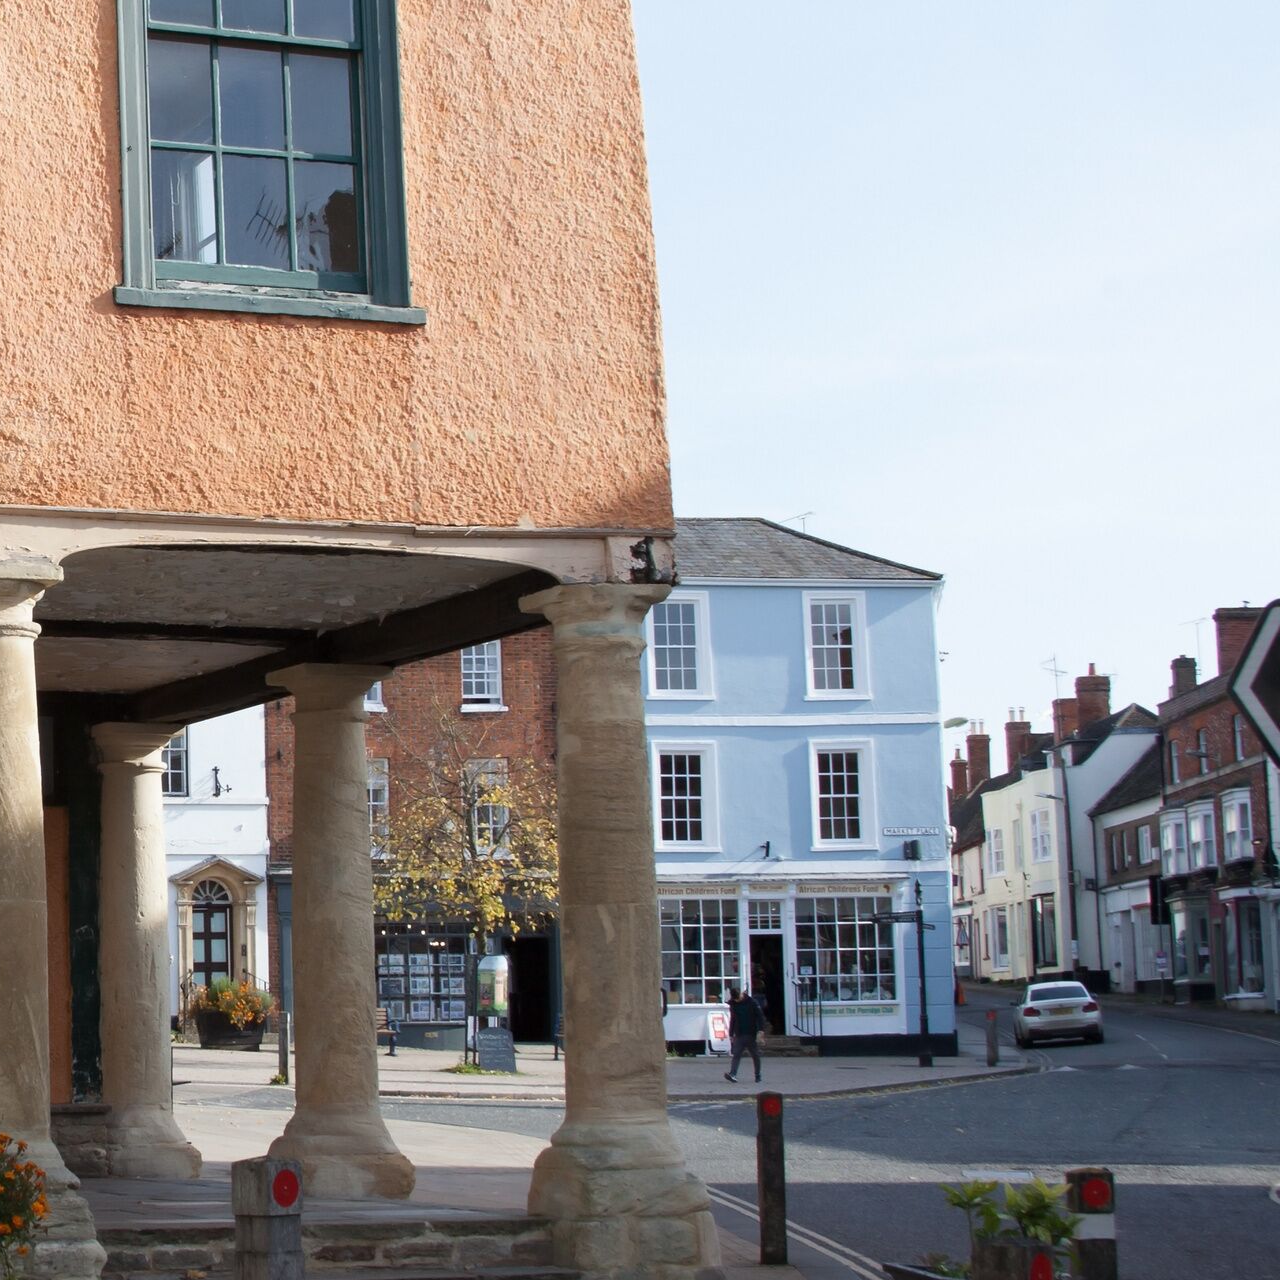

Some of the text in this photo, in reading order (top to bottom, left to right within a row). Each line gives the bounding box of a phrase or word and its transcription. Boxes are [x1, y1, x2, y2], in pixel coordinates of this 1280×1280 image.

[657, 887, 684, 895] African
[720, 887, 736, 895] Fund
[863, 885, 879, 893] Fund
